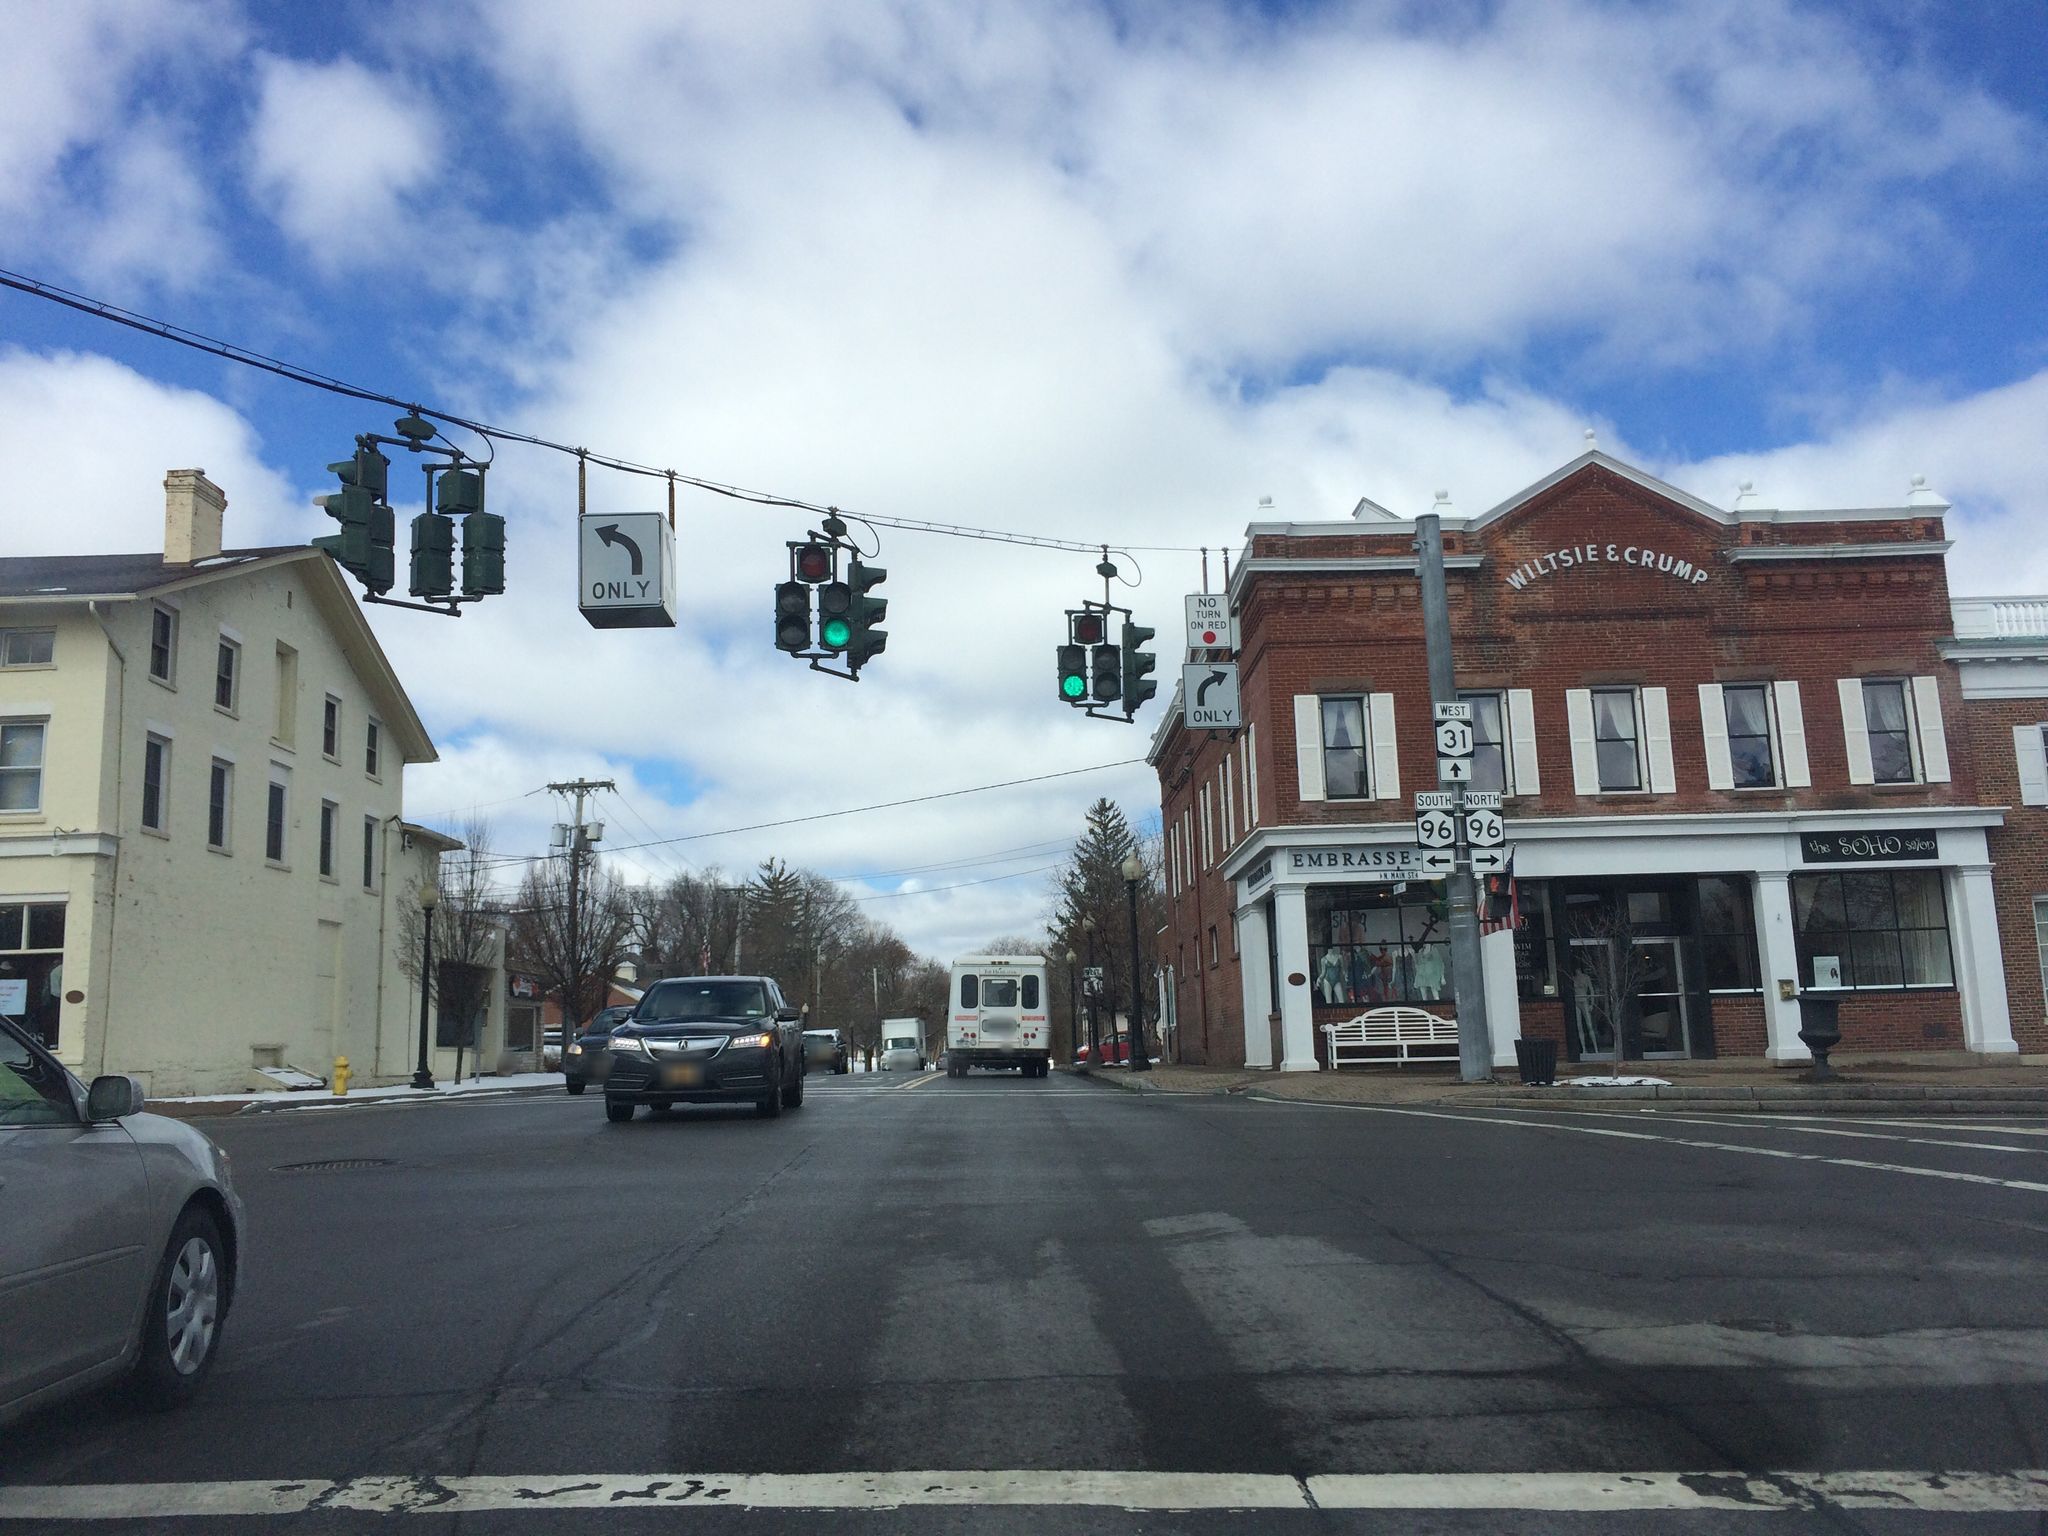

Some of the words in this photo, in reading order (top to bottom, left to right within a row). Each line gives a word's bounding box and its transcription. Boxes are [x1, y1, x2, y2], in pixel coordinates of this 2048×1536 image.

[1505, 544, 1599, 590] WILTSIE
[1606, 544, 1619, 562] &
[1623, 546, 1708, 585] CRUMP
[592, 580, 650, 599] ONLY
[1198, 597, 1217, 608] NO
[1196, 610, 1221, 619] TURN
[1190, 621, 1204, 630] ON
[1208, 620, 1227, 630] RED
[1193, 709, 1233, 723] ONLY
[1440, 705, 1466, 717] WEST
[1443, 729, 1467, 749] 31
[1417, 794, 1452, 807] SOUTH
[1465, 793, 1500, 806] NORTH
[1420, 819, 1452, 840] 96
[1469, 818, 1500, 839] 96
[1808, 839, 1831, 855] the
[1838, 834, 1902, 857] SOHO
[1905, 837, 1936, 852] salon
[1390, 871, 1405, 880] MAIN
